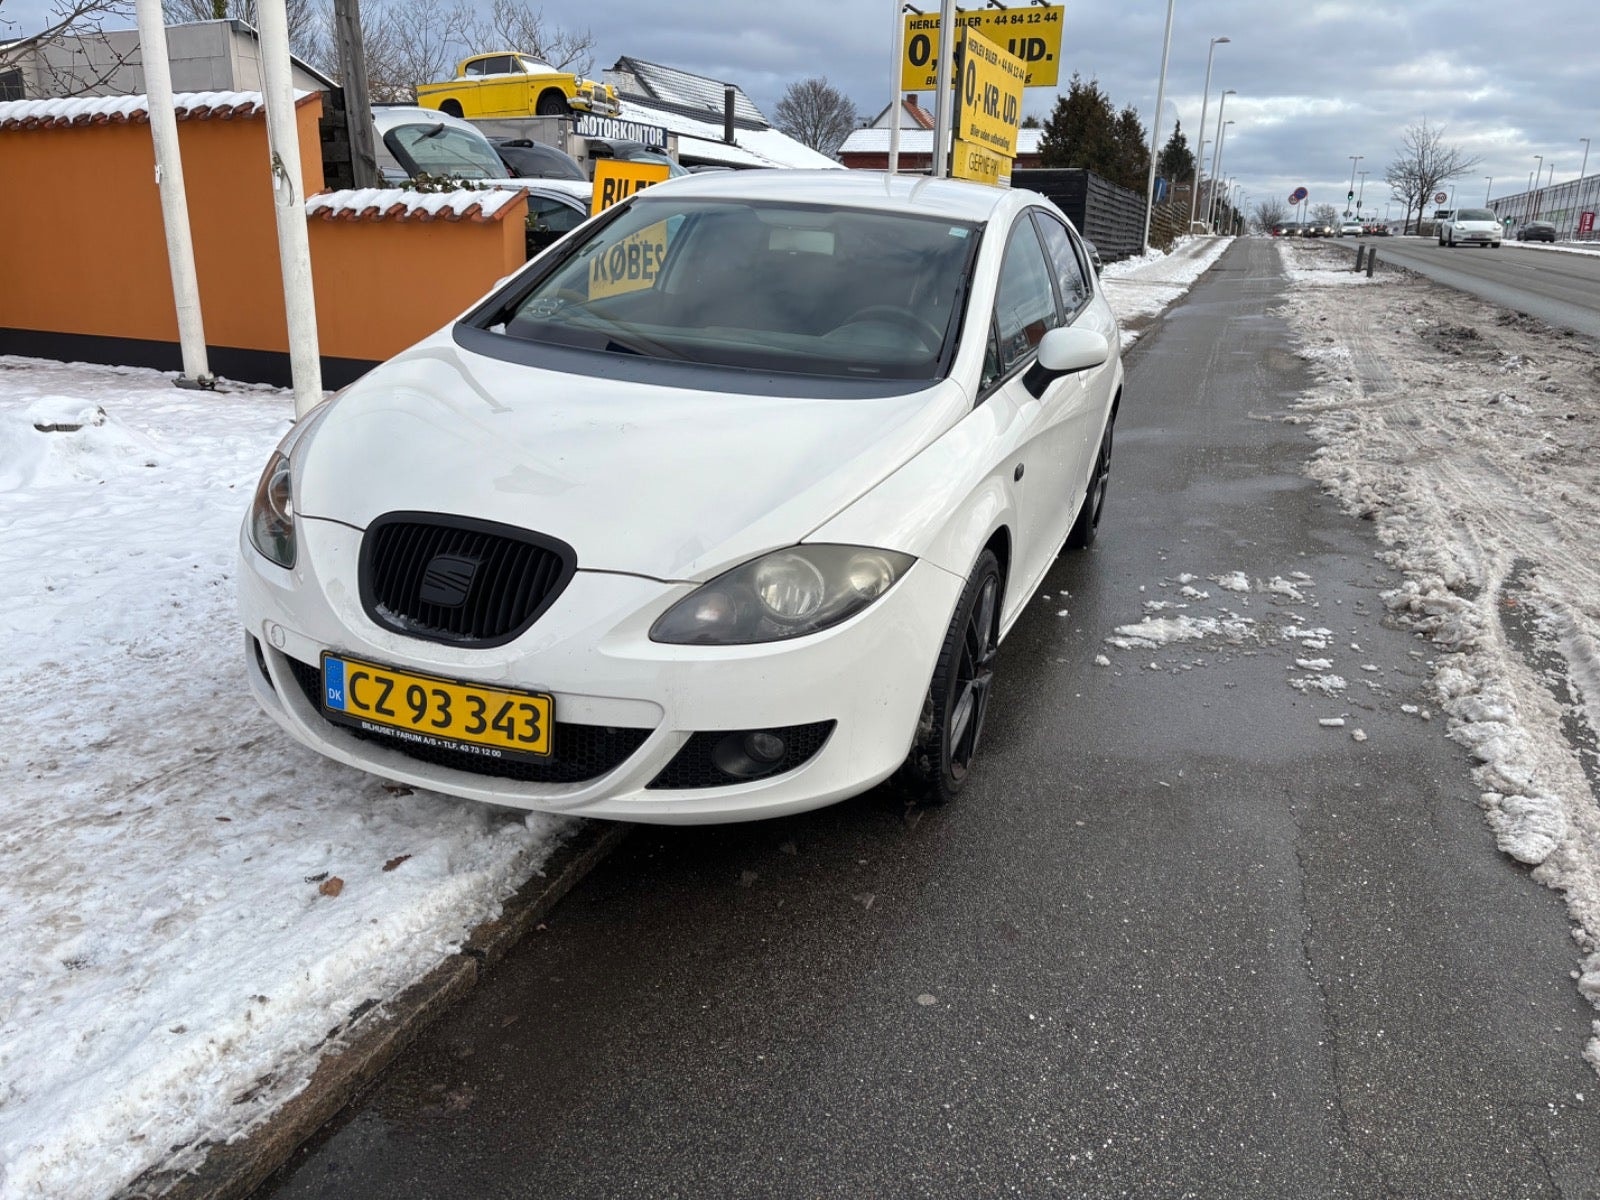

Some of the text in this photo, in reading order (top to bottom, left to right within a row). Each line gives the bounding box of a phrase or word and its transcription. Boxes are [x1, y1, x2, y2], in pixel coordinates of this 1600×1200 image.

[910, 19, 940, 30] HERLE
[994, 15, 1007, 25] 44
[1011, 14, 1024, 24] 84
[1027, 13, 1041, 23] 12
[1044, 12, 1058, 22] 44
[909, 34, 937, 71] 0,
[1008, 37, 1053, 62] UD.
[984, 82, 1000, 120] KR.
[1003, 92, 1018, 128] UD.
[577, 115, 664, 146] MOTORKONTOR
[328, 688, 342, 701] DK
[349, 671, 541, 743] CZ 93 343
[361, 721, 395, 736] BILHUSET
[396, 730, 422, 743] FARUM
[423, 736, 437, 746] A/S
[444, 741, 459, 750] TLF.
[470, 745, 480, 754] 73
[482, 747, 491, 756] 12
[491, 749, 502, 757] 00
